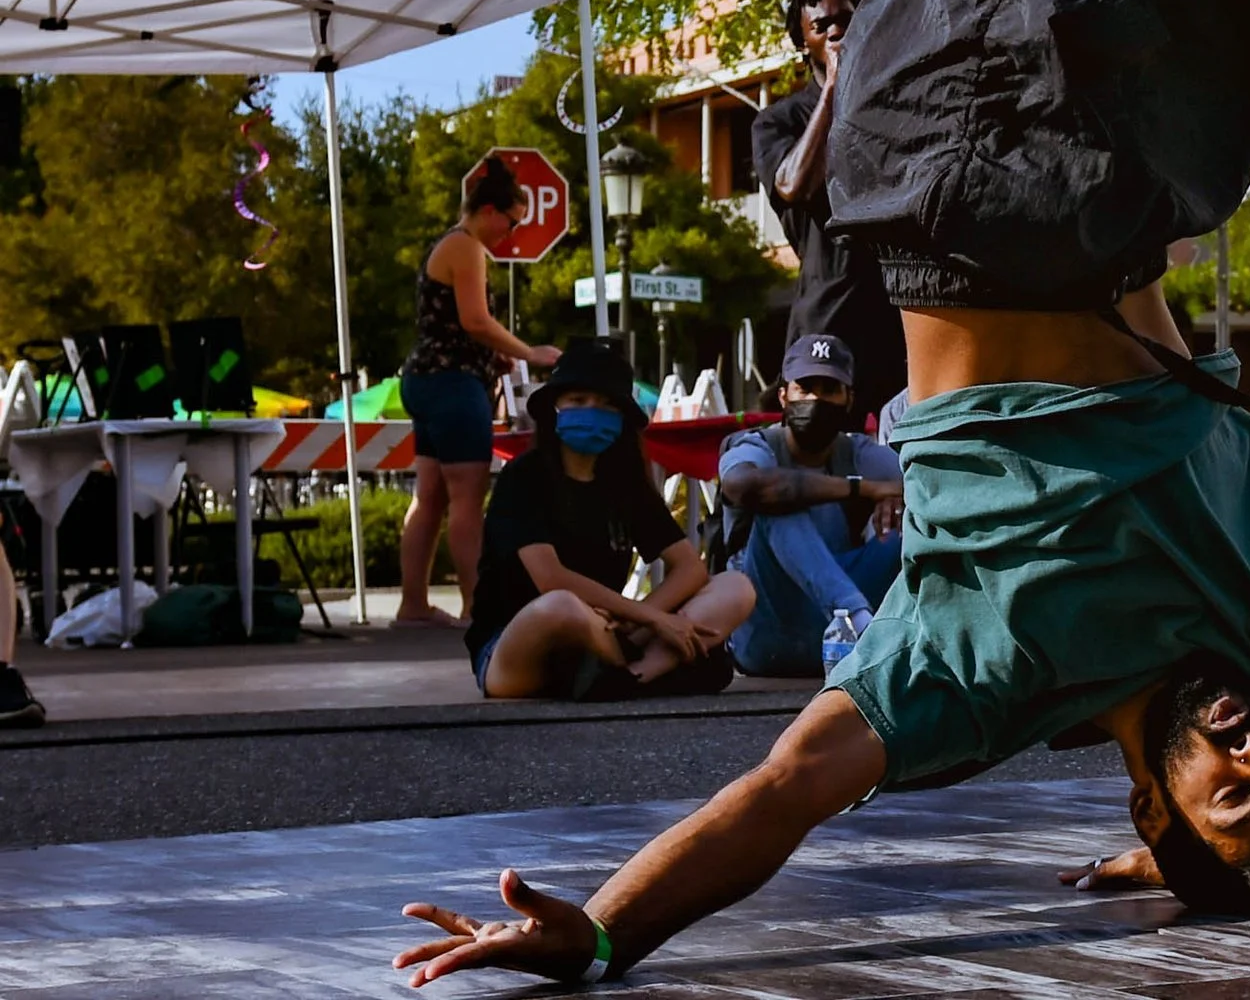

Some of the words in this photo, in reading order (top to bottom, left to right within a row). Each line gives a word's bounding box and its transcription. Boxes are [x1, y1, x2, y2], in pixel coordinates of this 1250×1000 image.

[633, 278, 661, 296] First
[664, 280, 681, 297] St.
[812, 341, 830, 359] NY
